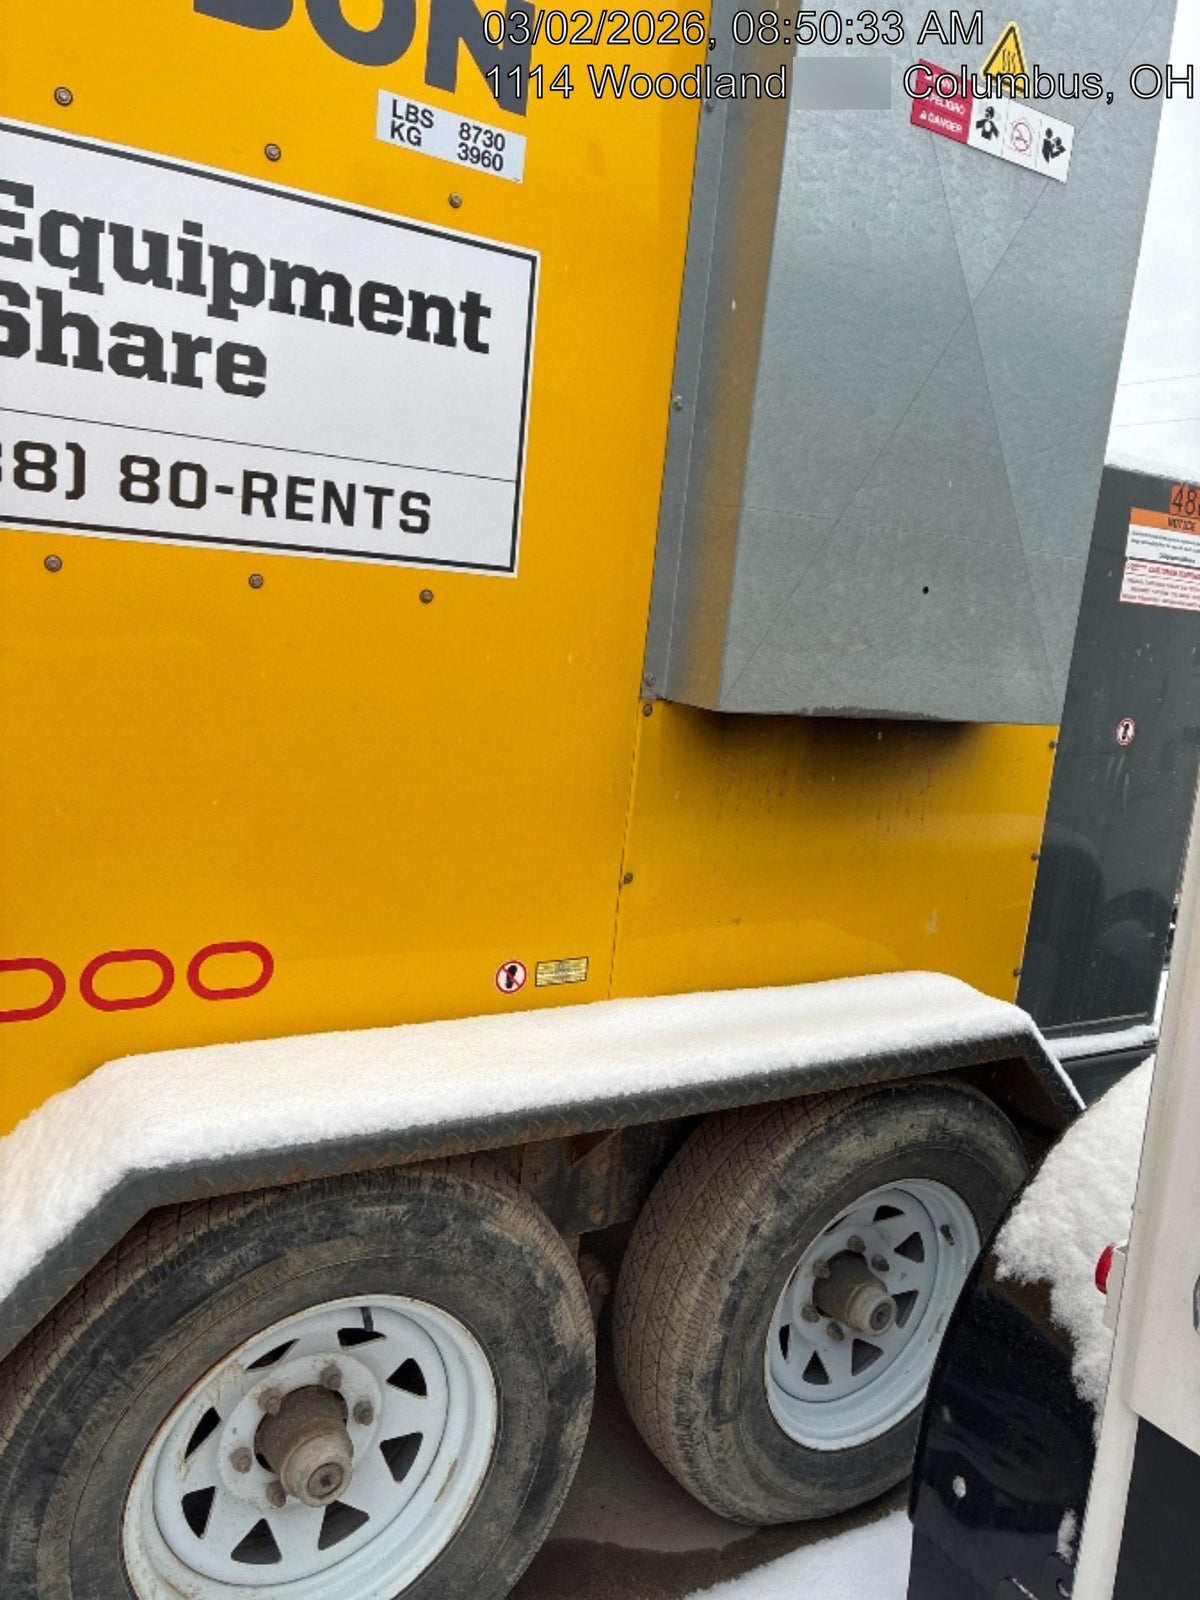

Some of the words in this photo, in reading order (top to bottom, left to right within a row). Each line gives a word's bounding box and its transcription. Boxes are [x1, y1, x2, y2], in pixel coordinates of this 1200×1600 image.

[193, 0, 536, 117] ON
[390, 120, 422, 147] KG
[457, 142, 504, 171] 3960
[392, 99, 434, 129] LBS
[459, 122, 506, 152] 8730
[0, 440, 86, 500] 8)
[119, 454, 431, 535] 80-RENTS
